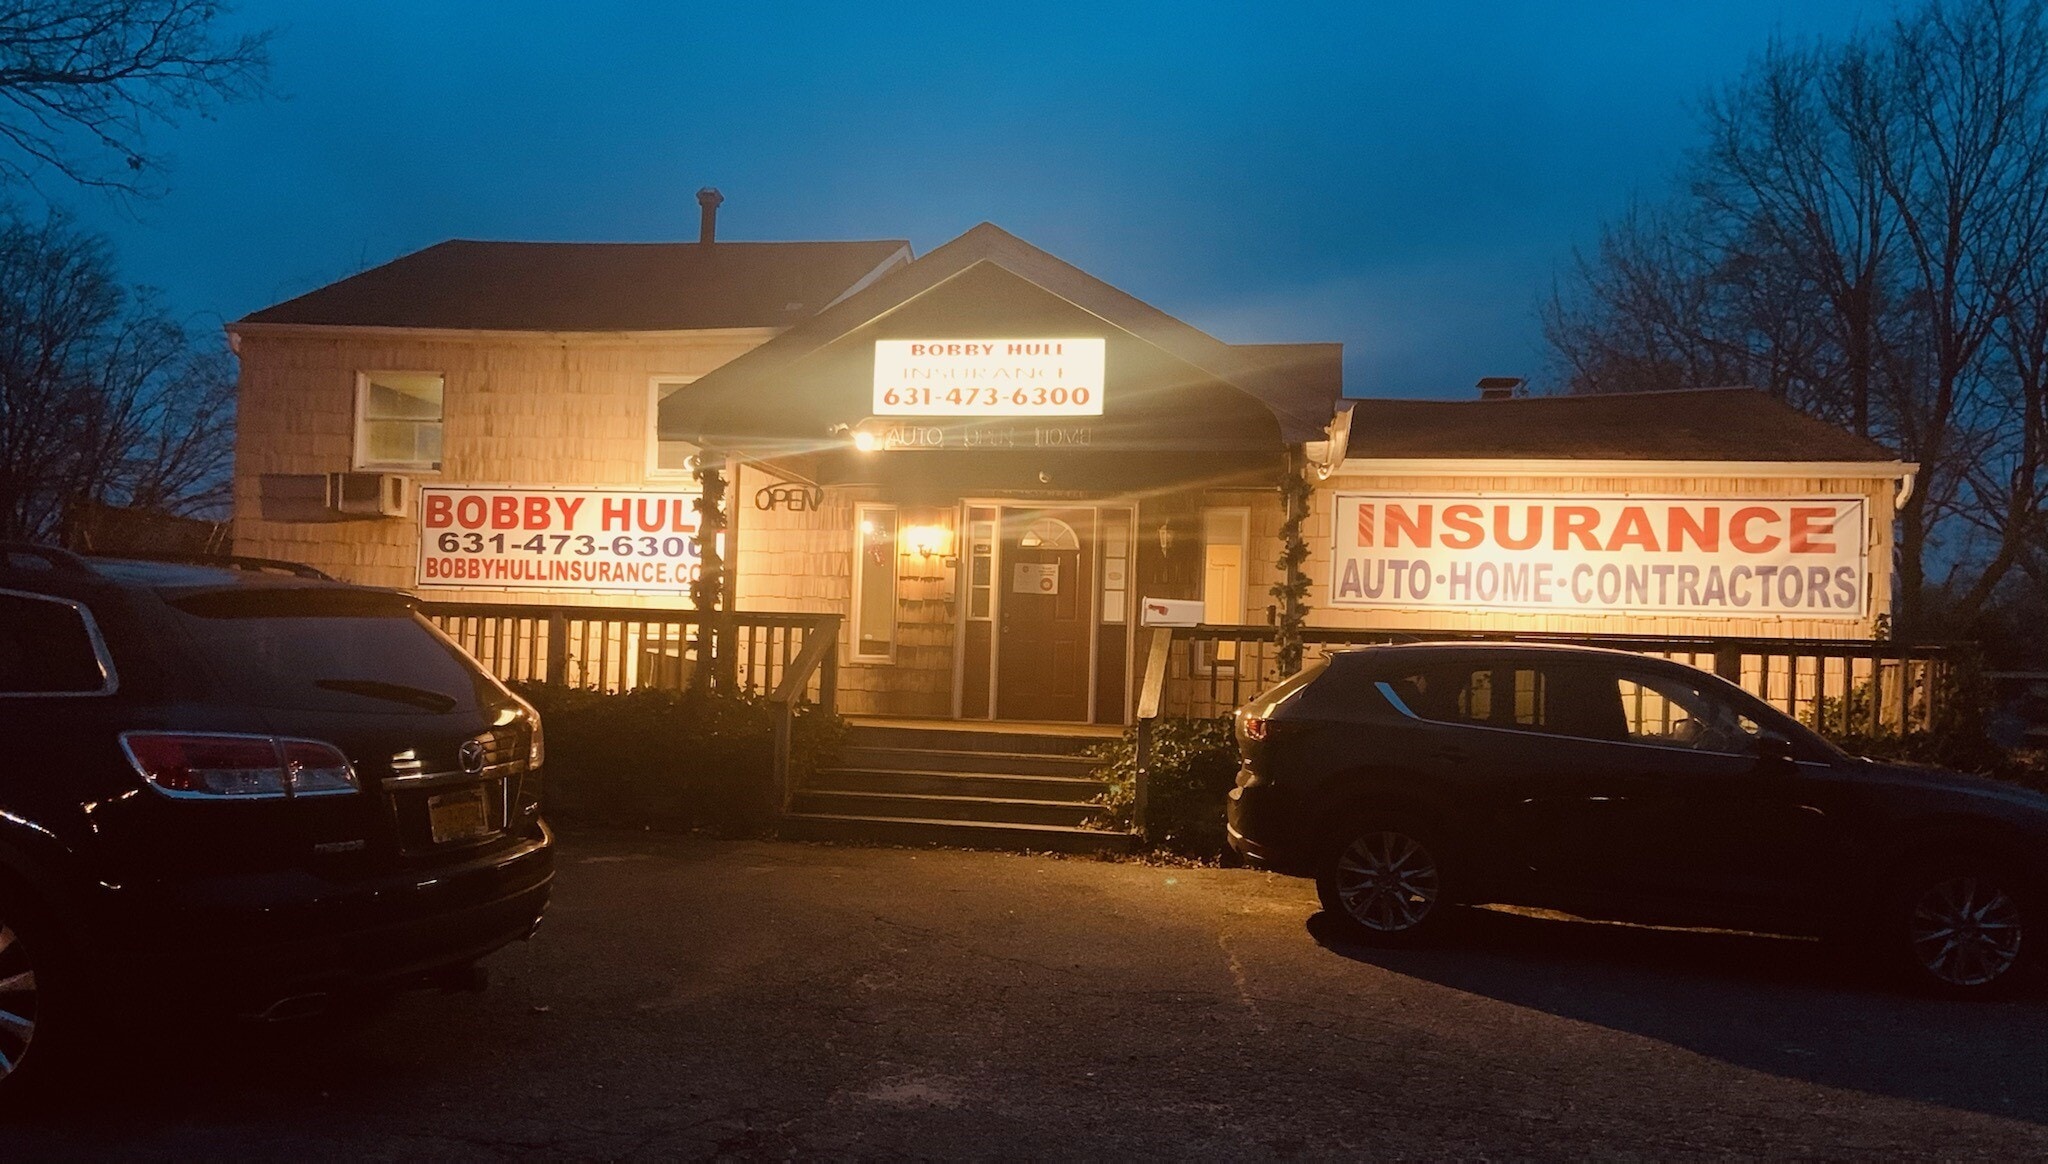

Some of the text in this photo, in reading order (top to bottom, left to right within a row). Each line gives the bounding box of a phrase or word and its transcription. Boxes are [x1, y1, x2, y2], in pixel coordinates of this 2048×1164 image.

[911, 343, 994, 357] BOBBY
[903, 367, 1064, 380] INURANE
[883, 387, 1090, 406] 631-473-6300
[888, 427, 943, 445] AUTO
[755, 487, 822, 512] OPEN
[425, 494, 728, 533] BOBBY HUL
[1357, 502, 1838, 554] INSURANCE
[425, 556, 702, 585] BOBBYHULLINSURANCE.CO
